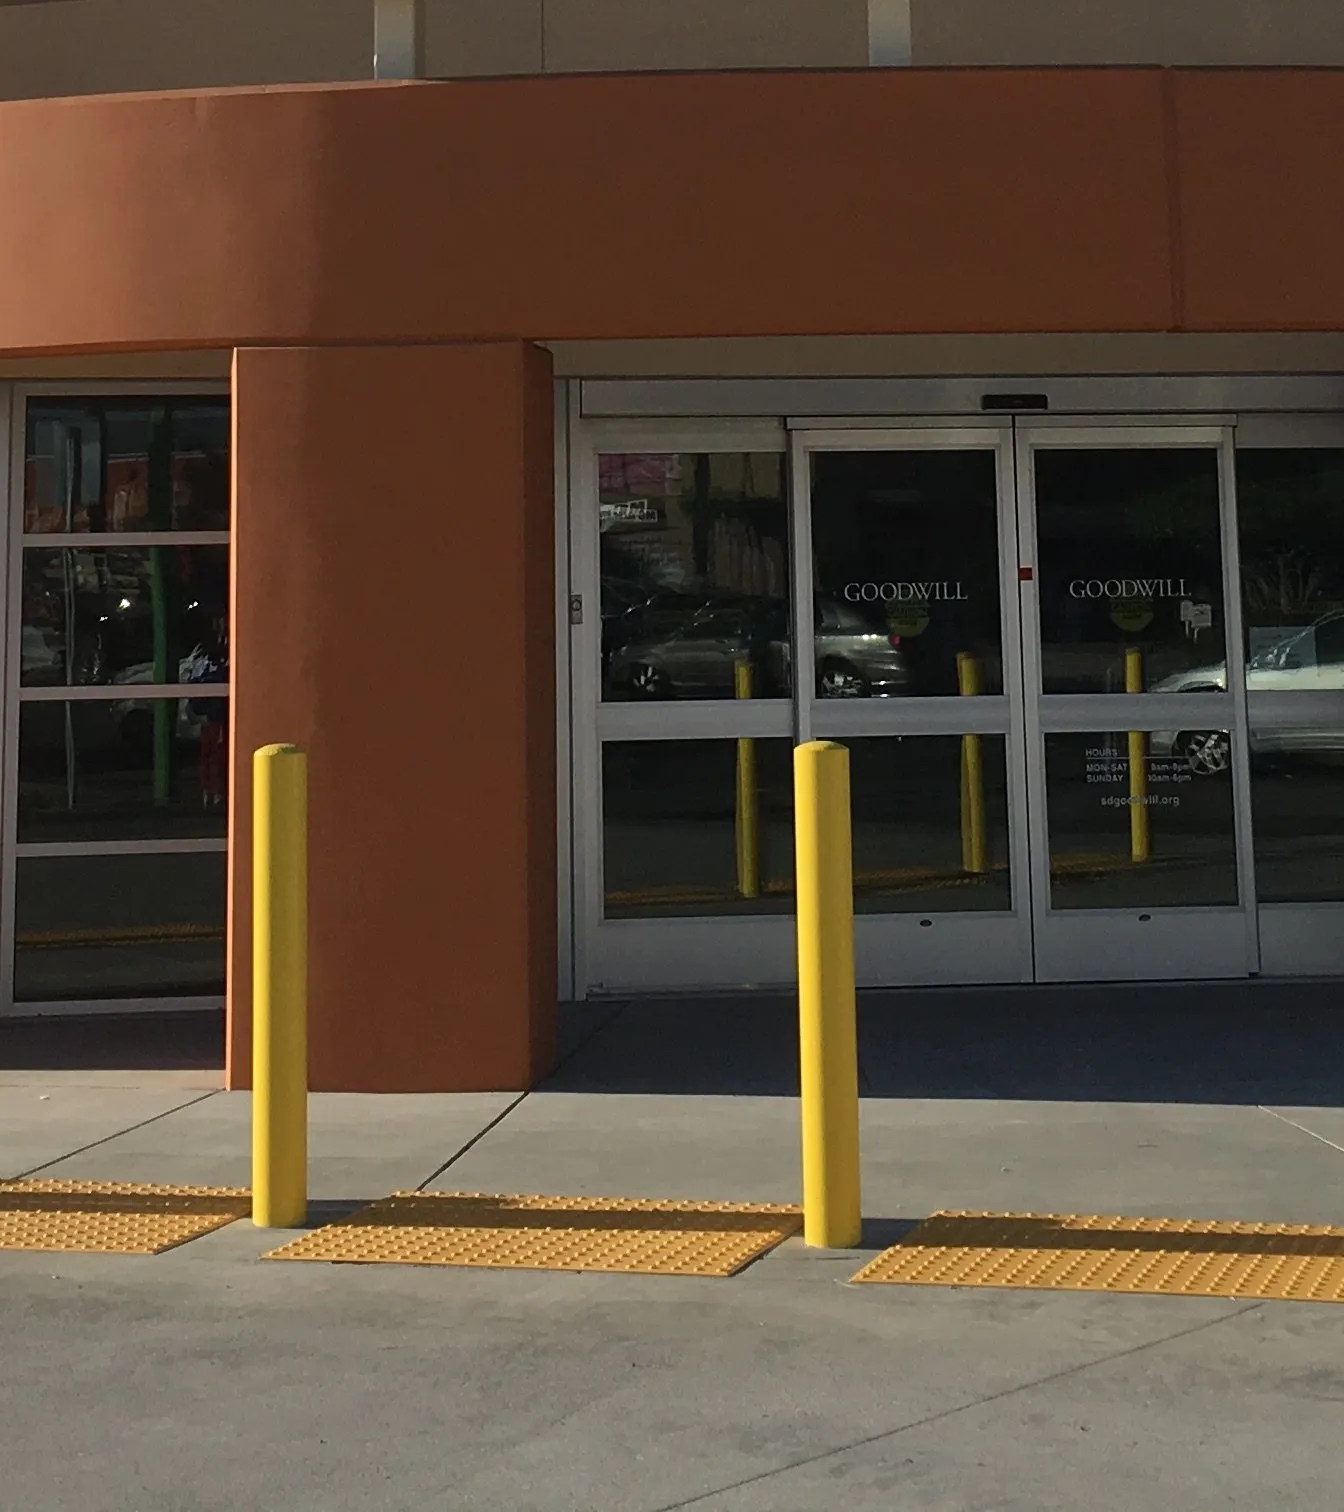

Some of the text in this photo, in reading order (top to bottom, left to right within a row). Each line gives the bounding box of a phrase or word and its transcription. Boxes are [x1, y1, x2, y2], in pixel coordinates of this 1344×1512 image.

[844, 581, 968, 601] GOODWILL
[1069, 579, 1192, 598] GOODWILL
[1086, 774, 1123, 783] SUNDAY
